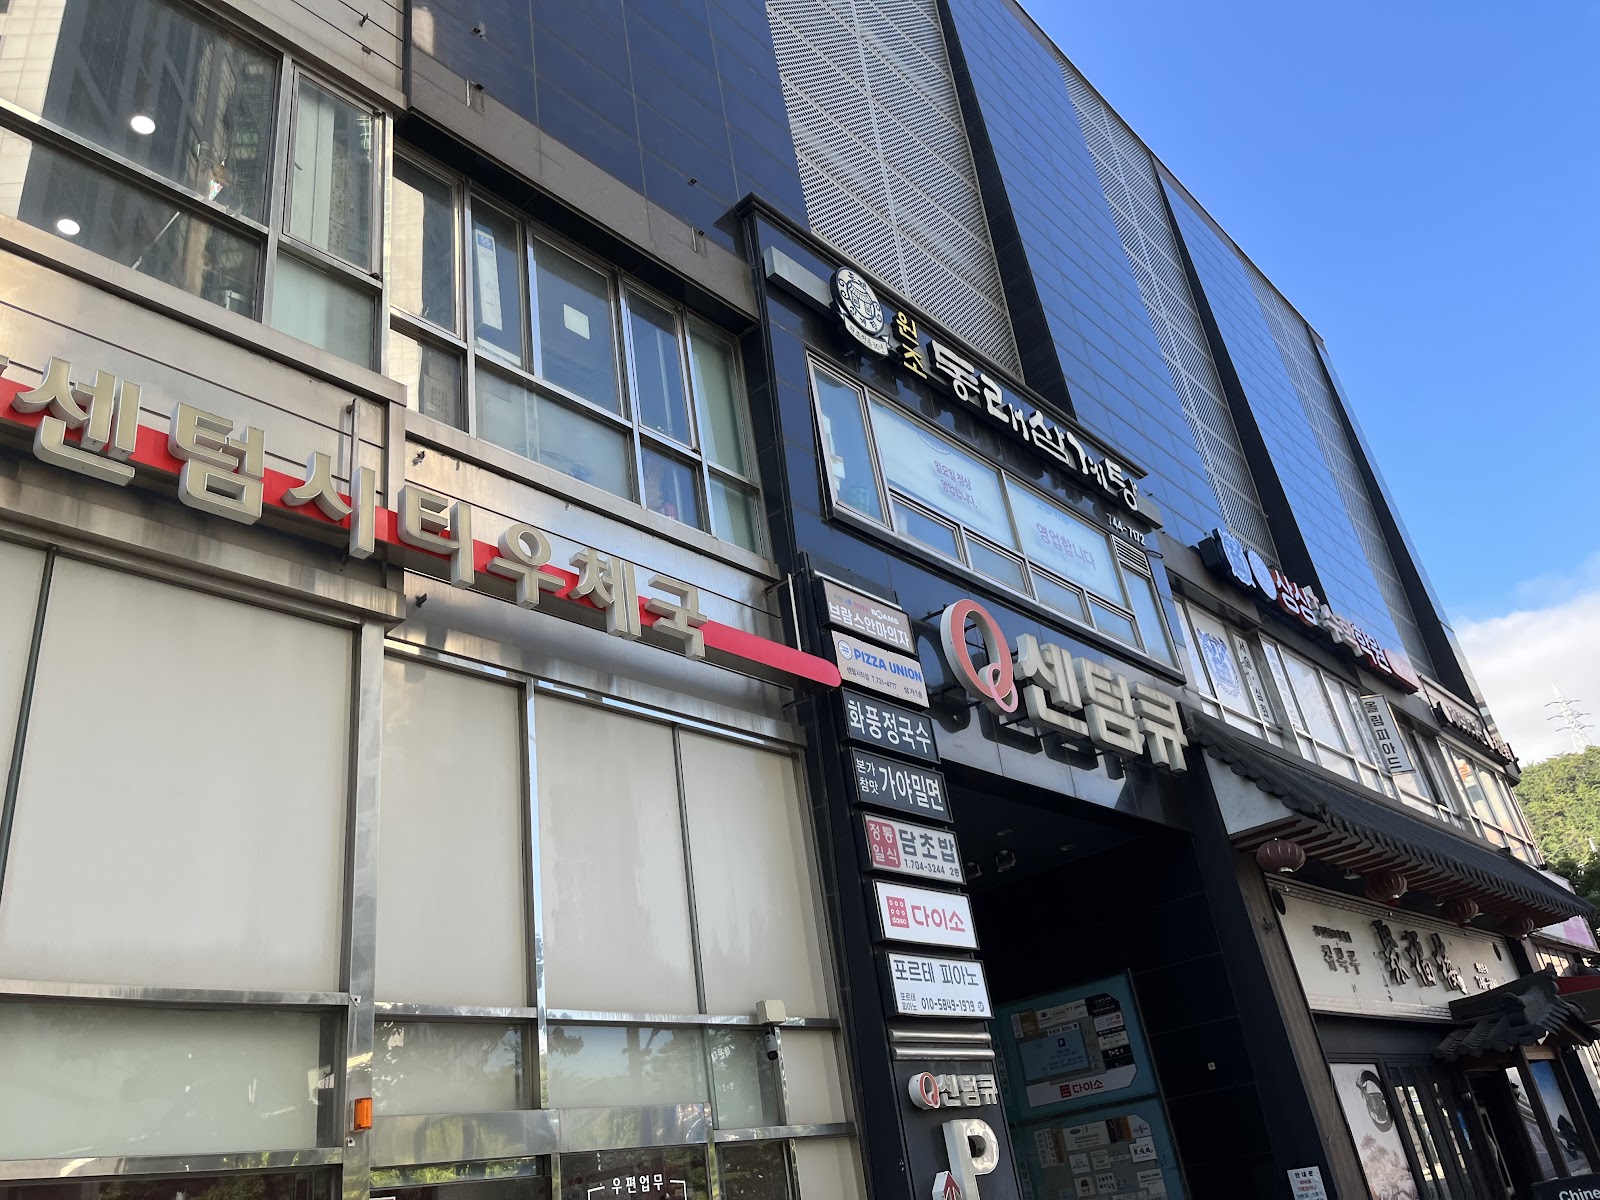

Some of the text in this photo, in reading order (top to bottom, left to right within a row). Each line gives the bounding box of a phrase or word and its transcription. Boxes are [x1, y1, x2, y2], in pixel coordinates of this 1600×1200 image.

[896, 311, 928, 380] 원조
[11, 355, 707, 661] 센텀시티우체국
[1037, 522, 1096, 570] 영업합니다
[1106, 512, 1146, 546] 744-7172
[828, 602, 909, 648] 브람스안마의자
[853, 648, 922, 683] PIZZA UNION
[942, 599, 1018, 713] Q
[1014, 633, 1188, 773] 센텀큐
[848, 699, 931, 754] 화풍정국수
[856, 758, 944, 812] 본가 가야밀면
[860, 776, 879, 795] 참맛
[869, 823, 956, 864] 정통 담초밥
[873, 844, 898, 865] 일식
[904, 859, 945, 875] T.704-3244
[911, 904, 966, 932] 다이소
[894, 959, 979, 986] 포르테 피아노
[921, 997, 975, 1013] 010-5849-1979
[912, 1071, 940, 1109] Q
[938, 1073, 998, 1107] 센텀큐
[1073, 1079, 1104, 1094] 다이소
[943, 1119, 999, 1200] P
[611, 1174, 664, 1195] 우편업무
